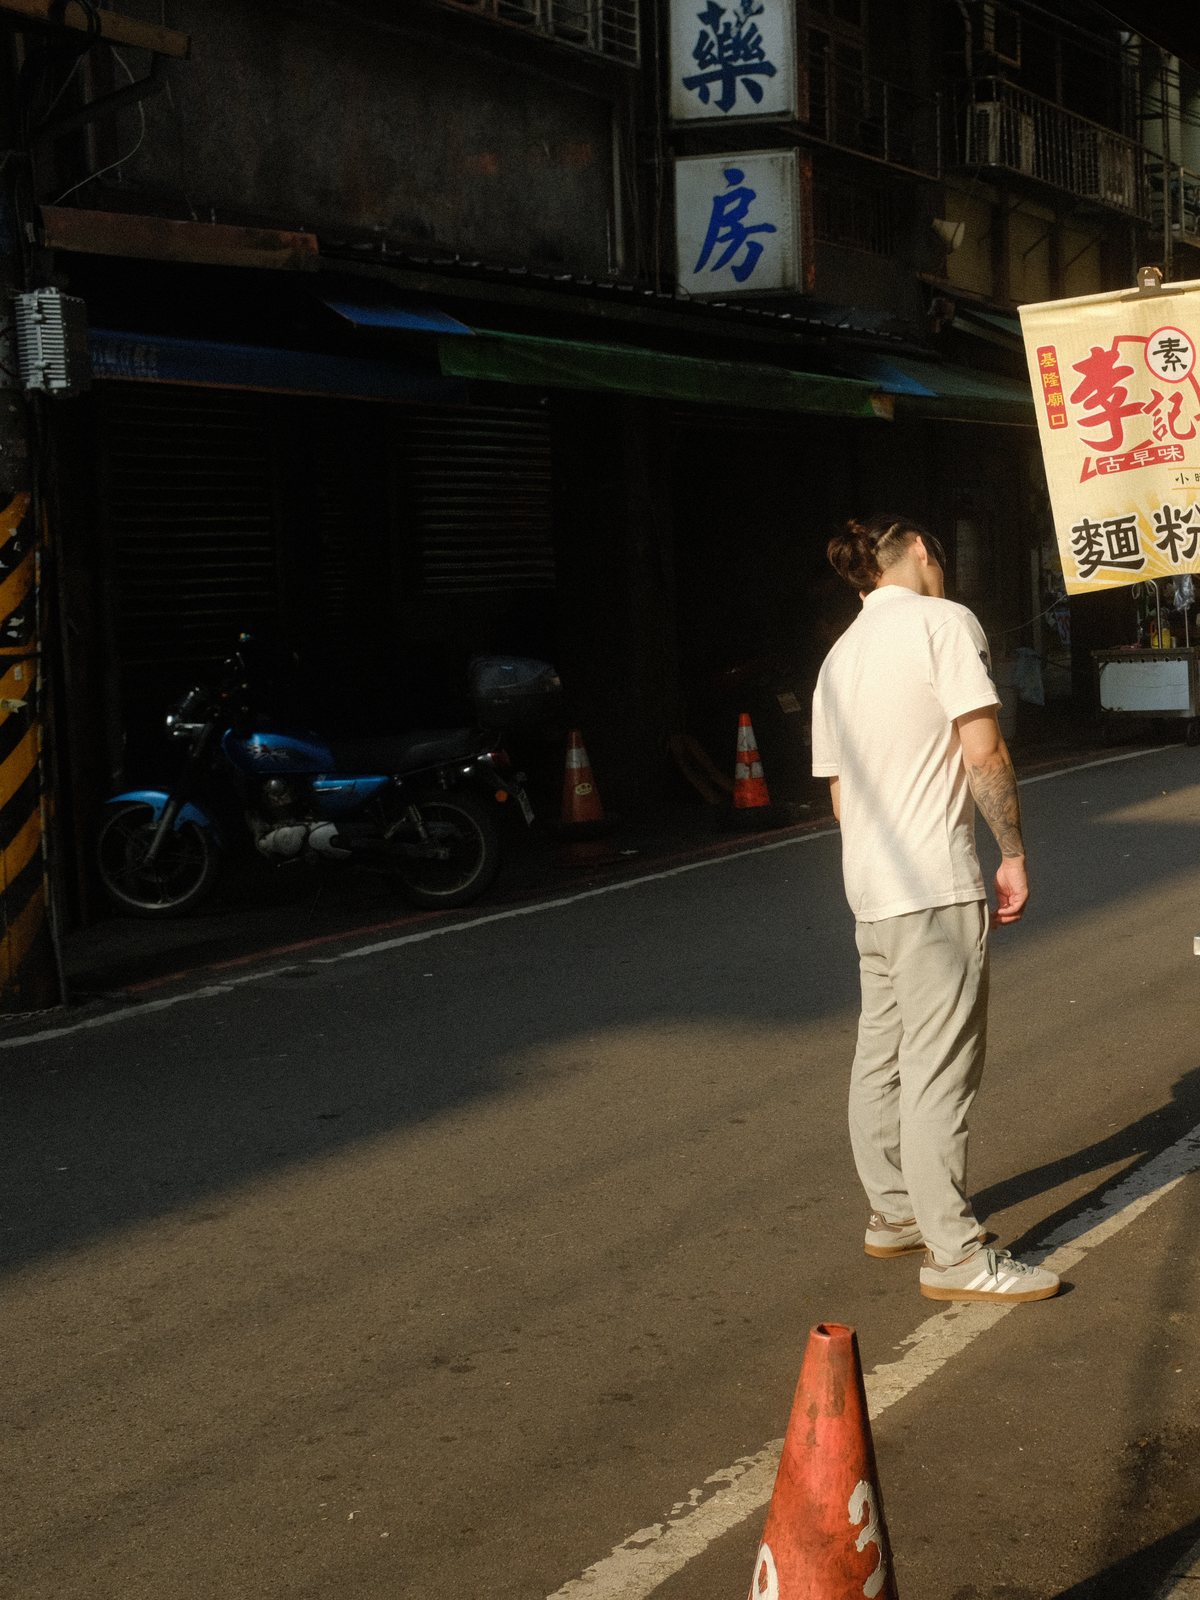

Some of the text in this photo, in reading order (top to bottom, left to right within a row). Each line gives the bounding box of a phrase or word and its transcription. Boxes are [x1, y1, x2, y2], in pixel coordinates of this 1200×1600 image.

[1152, 336, 1190, 373] 素
[1040, 351, 1066, 427] 基隆廟口
[1070, 346, 1197, 452] 李記
[1098, 445, 1184, 473] 古早味
